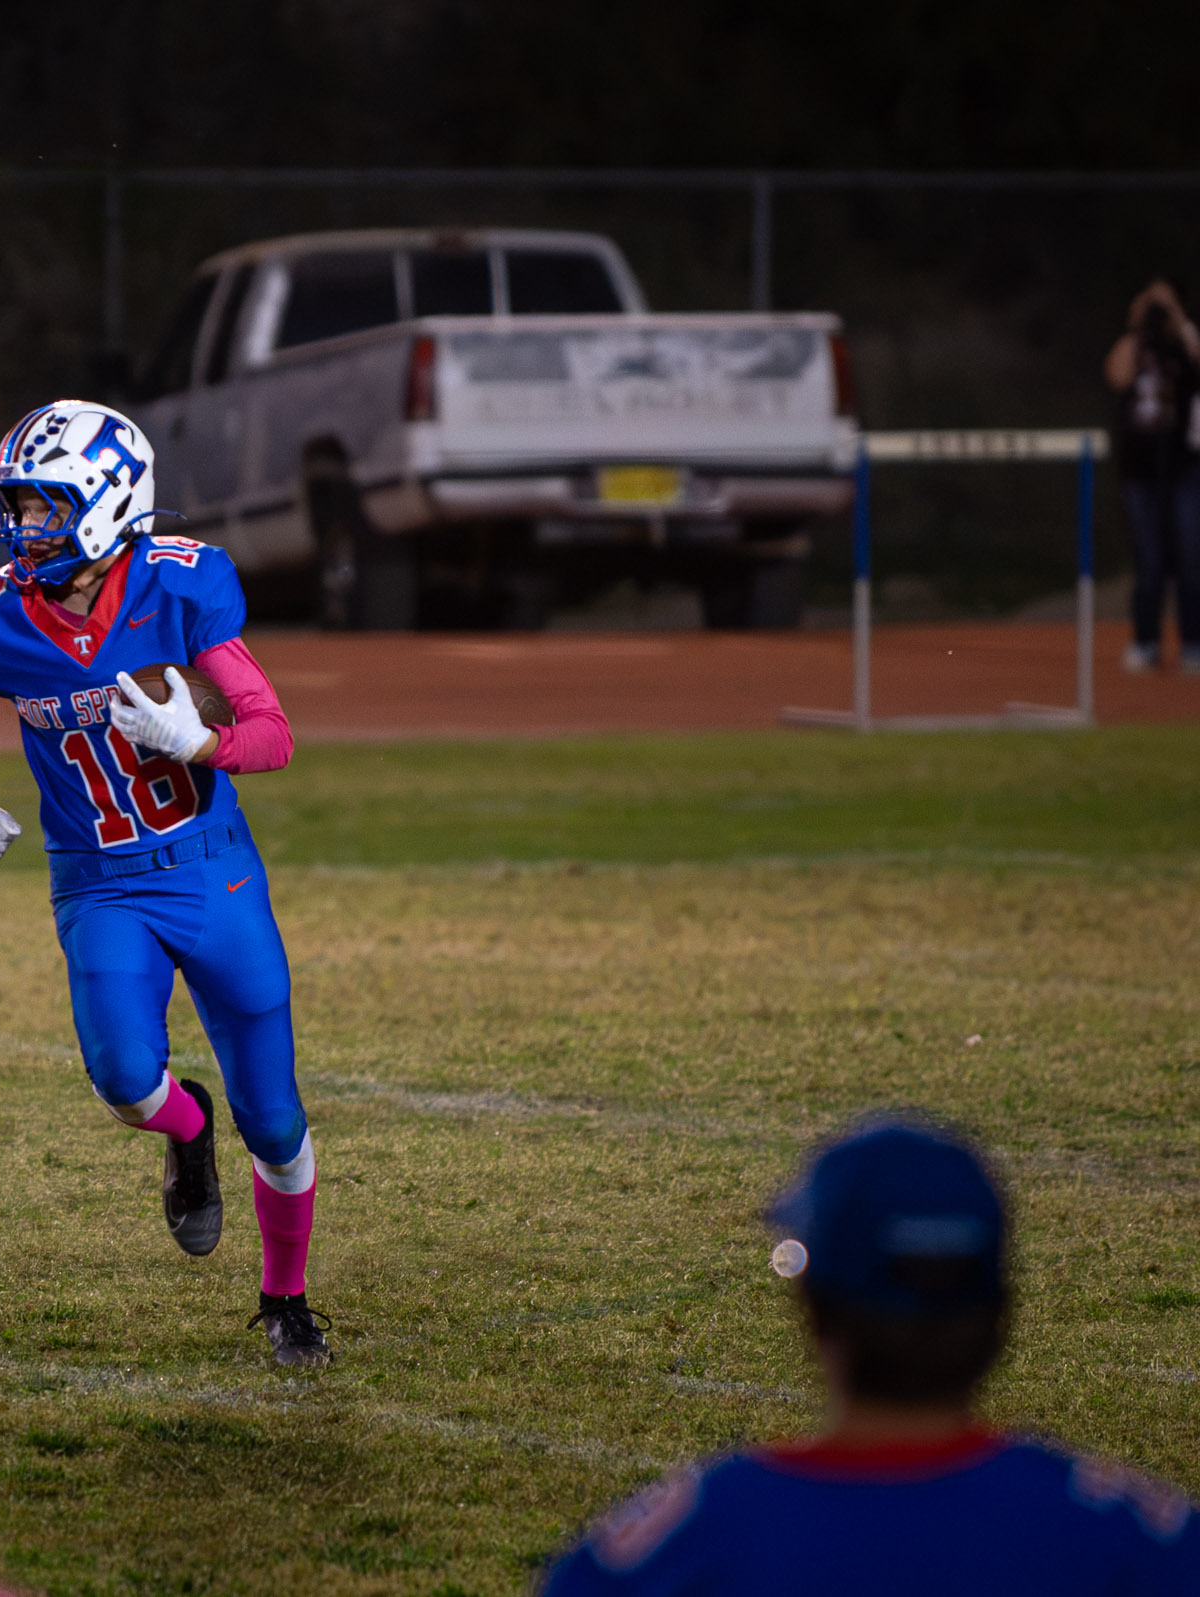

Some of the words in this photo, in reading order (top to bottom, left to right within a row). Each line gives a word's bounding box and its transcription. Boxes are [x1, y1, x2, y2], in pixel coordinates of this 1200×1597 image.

[73, 634, 92, 655] T
[15, 695, 66, 730] HOT
[60, 725, 200, 849] 18
